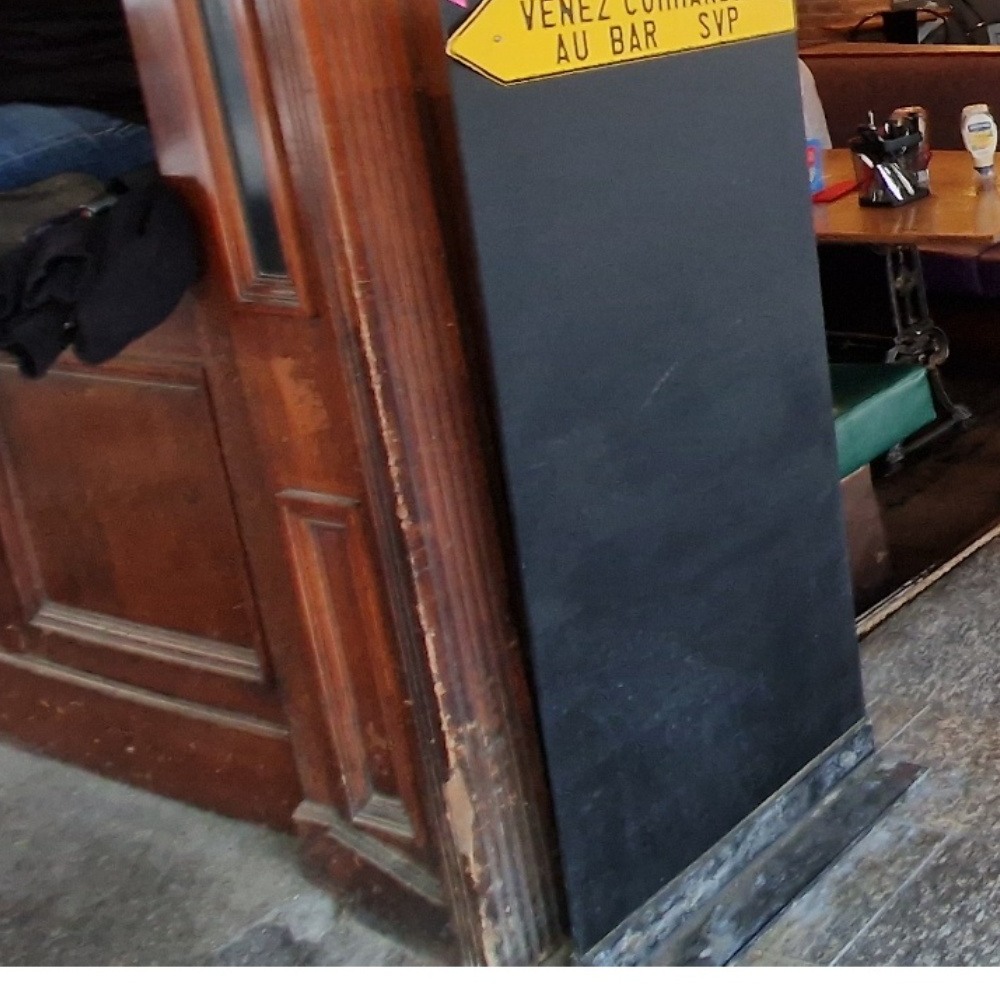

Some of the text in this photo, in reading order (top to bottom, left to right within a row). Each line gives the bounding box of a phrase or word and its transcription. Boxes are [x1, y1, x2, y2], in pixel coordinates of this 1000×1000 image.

[556, 7, 740, 65] AU BAR SVP
